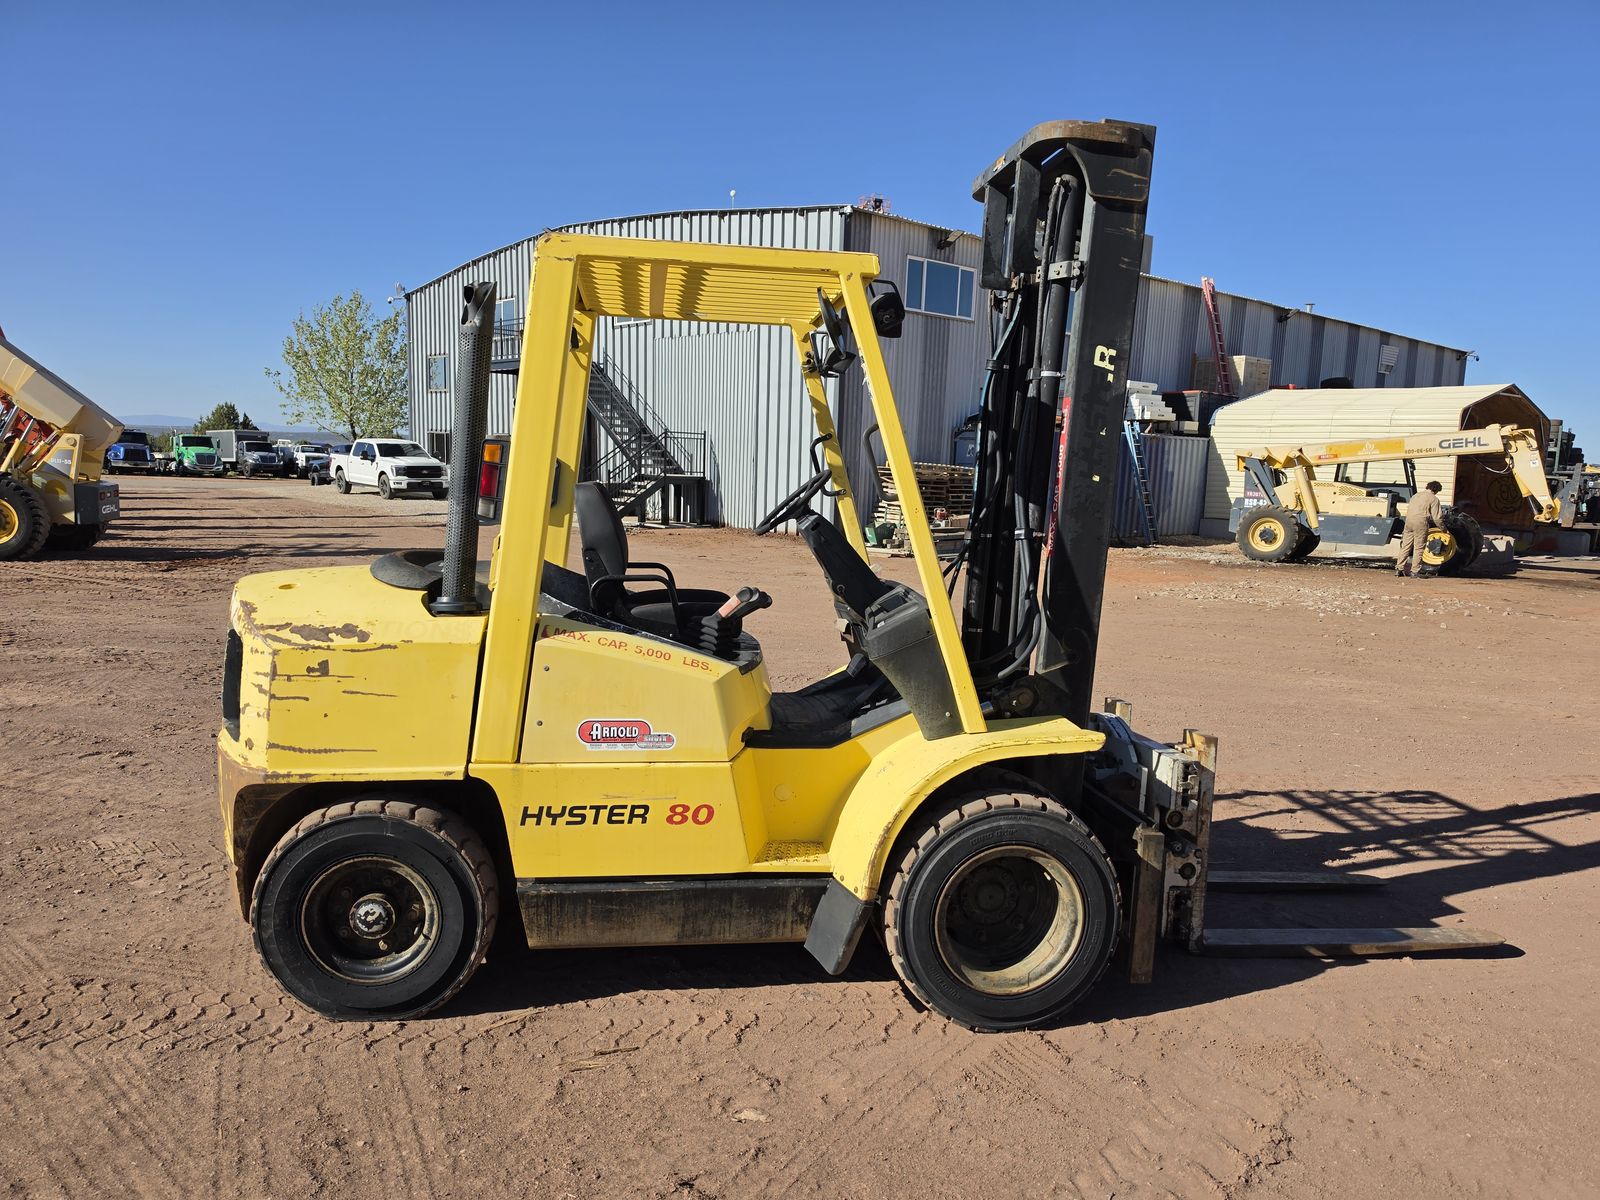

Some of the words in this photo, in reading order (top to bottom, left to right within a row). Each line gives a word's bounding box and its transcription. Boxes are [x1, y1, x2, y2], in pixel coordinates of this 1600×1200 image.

[1438, 436, 1489, 450] GEHL
[101, 505, 118, 514] GEHL
[553, 627, 591, 643] MAX.
[597, 636, 628, 651] CAP.
[634, 645, 671, 661] 5,000
[682, 656, 713, 672] LBS.
[590, 722, 640, 740] ARNOLD
[520, 804, 650, 826] HYSTER
[665, 803, 715, 826] 80
